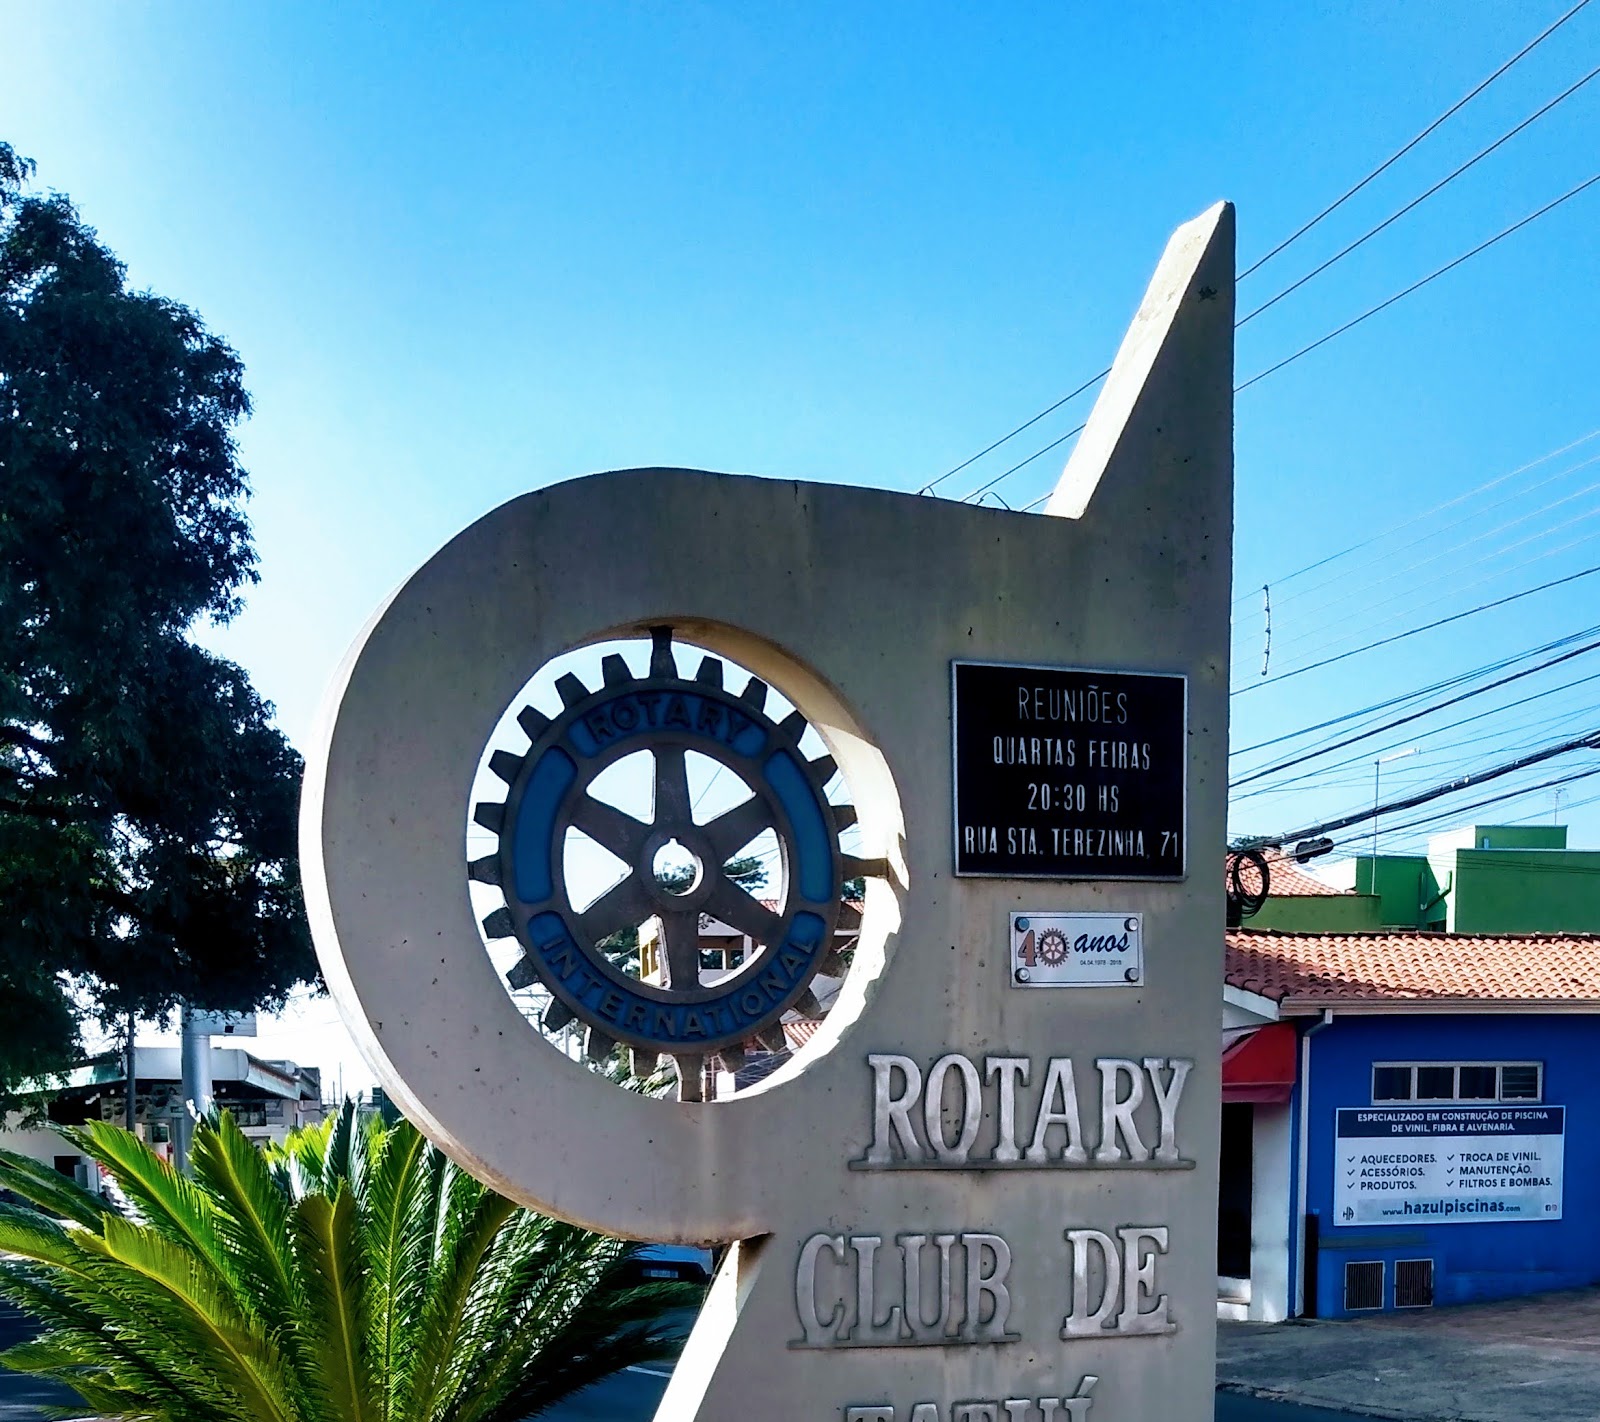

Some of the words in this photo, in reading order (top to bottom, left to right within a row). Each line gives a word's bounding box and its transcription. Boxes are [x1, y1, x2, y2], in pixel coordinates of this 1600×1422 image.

[1018, 685, 1128, 725] REUNIÕES
[585, 695, 754, 745] ROTARY
[993, 735, 1076, 767] QUARTAS
[1089, 739, 1151, 770] FEIRAS
[1027, 783, 1086, 812] 20:30
[1098, 785, 1119, 813] HS
[965, 826, 997, 854] RUA
[1008, 827, 1044, 855] STA.
[1161, 831, 1178, 857] 71
[1074, 932, 1131, 954] anos
[541, 936, 820, 1037] INTERNATIONAL
[862, 1053, 1196, 1168] ROTARY
[1357, 1112, 1425, 1122] ESPECIALIZADO
[1427, 1112, 1439, 1121] EM
[1441, 1110, 1499, 1122] CONSTRUÇÃO
[1501, 1111, 1512, 1120] DE
[1515, 1111, 1548, 1120] PISCINA
[1391, 1124, 1403, 1133] DE
[1432, 1123, 1457, 1132] FIBRA
[1460, 1123, 1465, 1132] E
[1360, 1153, 1437, 1165] AQUECEDORES.
[1459, 1152, 1493, 1162] TROCA
[1496, 1152, 1509, 1161] DE
[1512, 1151, 1541, 1161] VINIL.
[1360, 1165, 1425, 1177] ACESSÓRIOS.
[1459, 1163, 1532, 1176] MANUTENÇÃO.
[1360, 1181, 1417, 1191] PRODUTOS.
[1459, 1179, 1497, 1188] FILTROS
[1501, 1178, 1506, 1187] E
[1509, 1177, 1552, 1187] BOMBAS.
[1382, 1198, 1521, 1216] www.hazulpiscinas.com
[794, 1232, 1015, 1346] CLUB
[1062, 1226, 1176, 1338] DE
